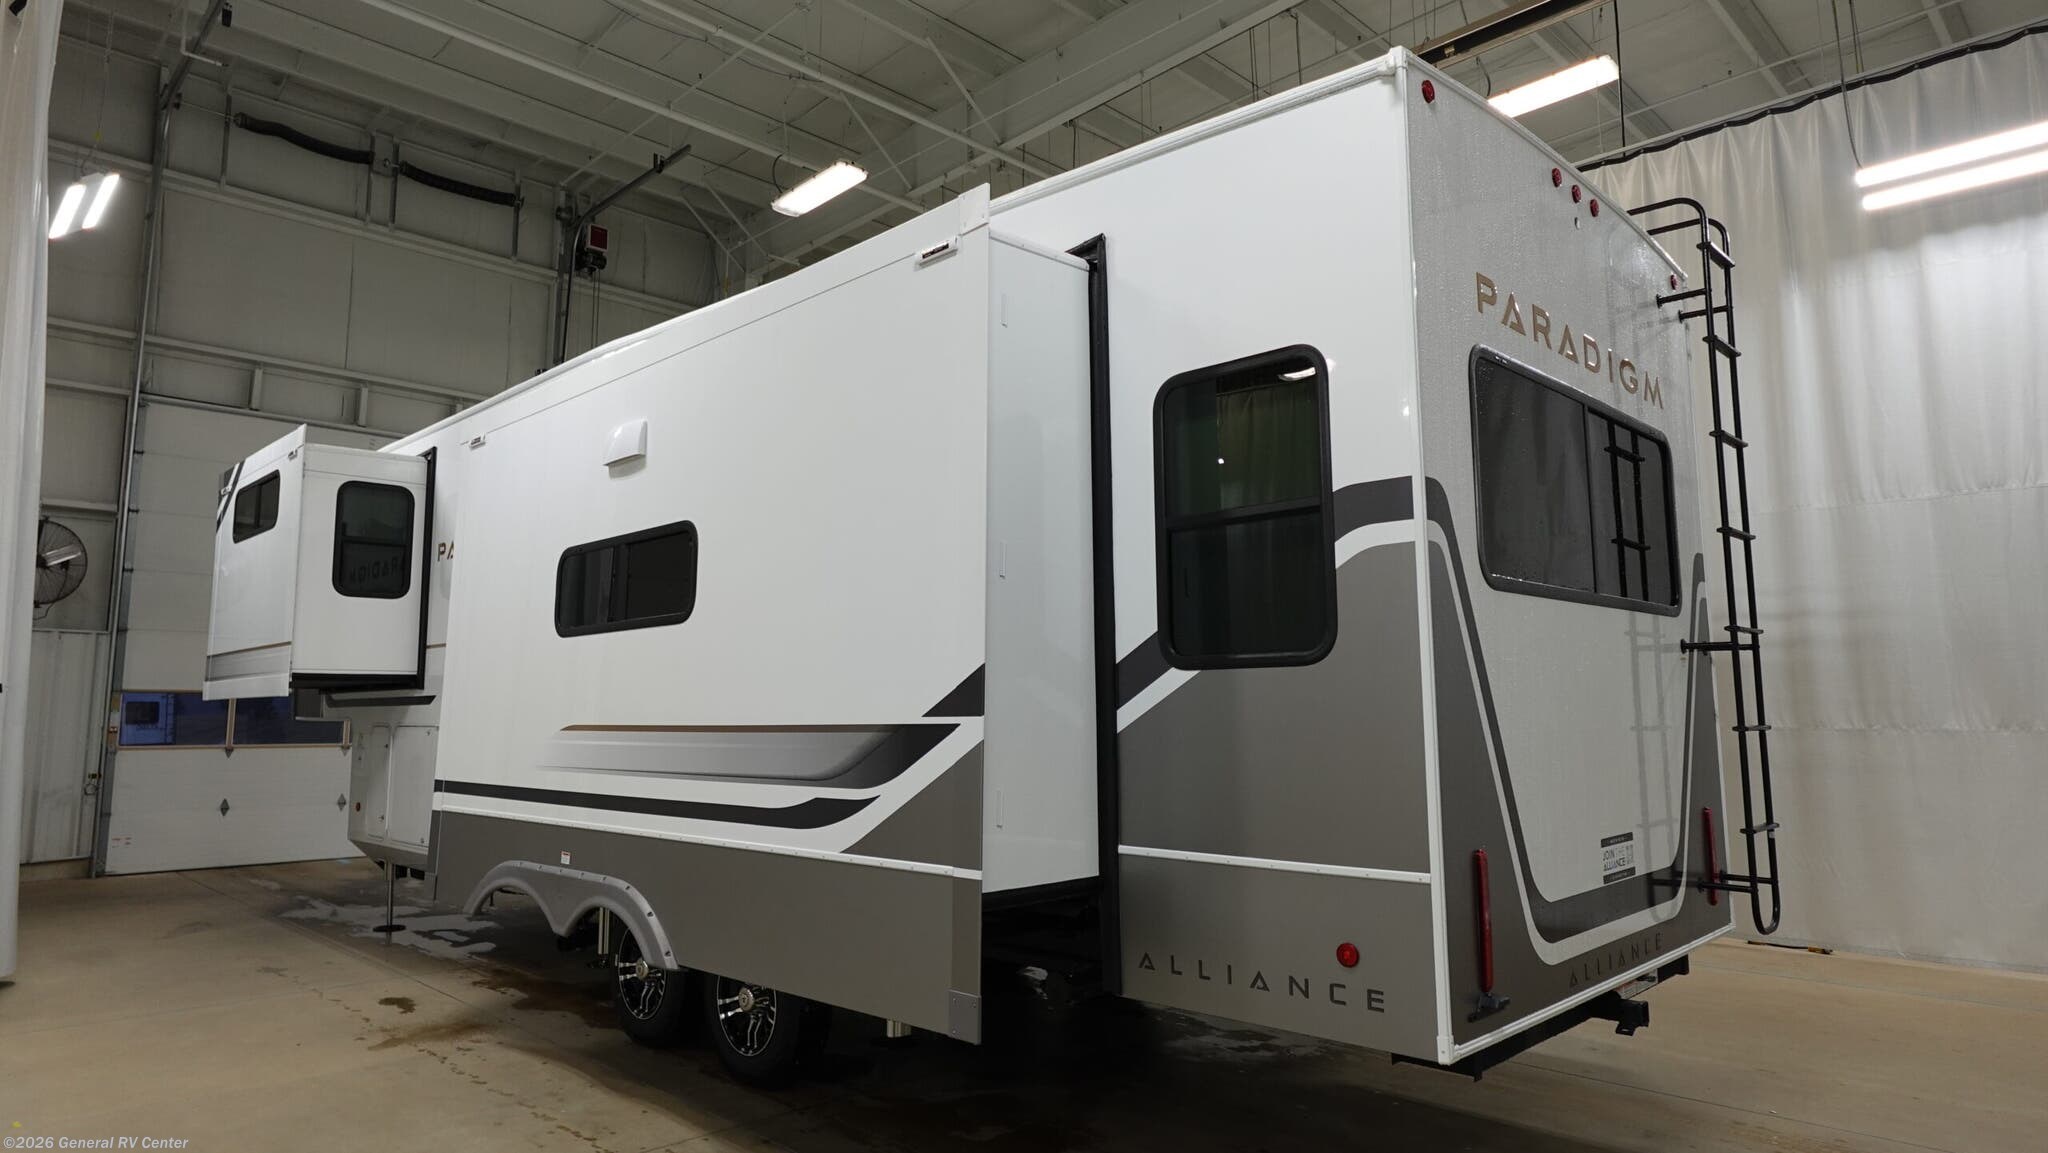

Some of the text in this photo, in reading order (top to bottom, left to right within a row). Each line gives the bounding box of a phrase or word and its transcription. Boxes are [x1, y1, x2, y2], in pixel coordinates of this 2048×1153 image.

[1475, 271, 1665, 409] PARADIGM
[1138, 951, 1386, 1014] ALLIANCE
[1569, 931, 1664, 989] ALLIANCE
